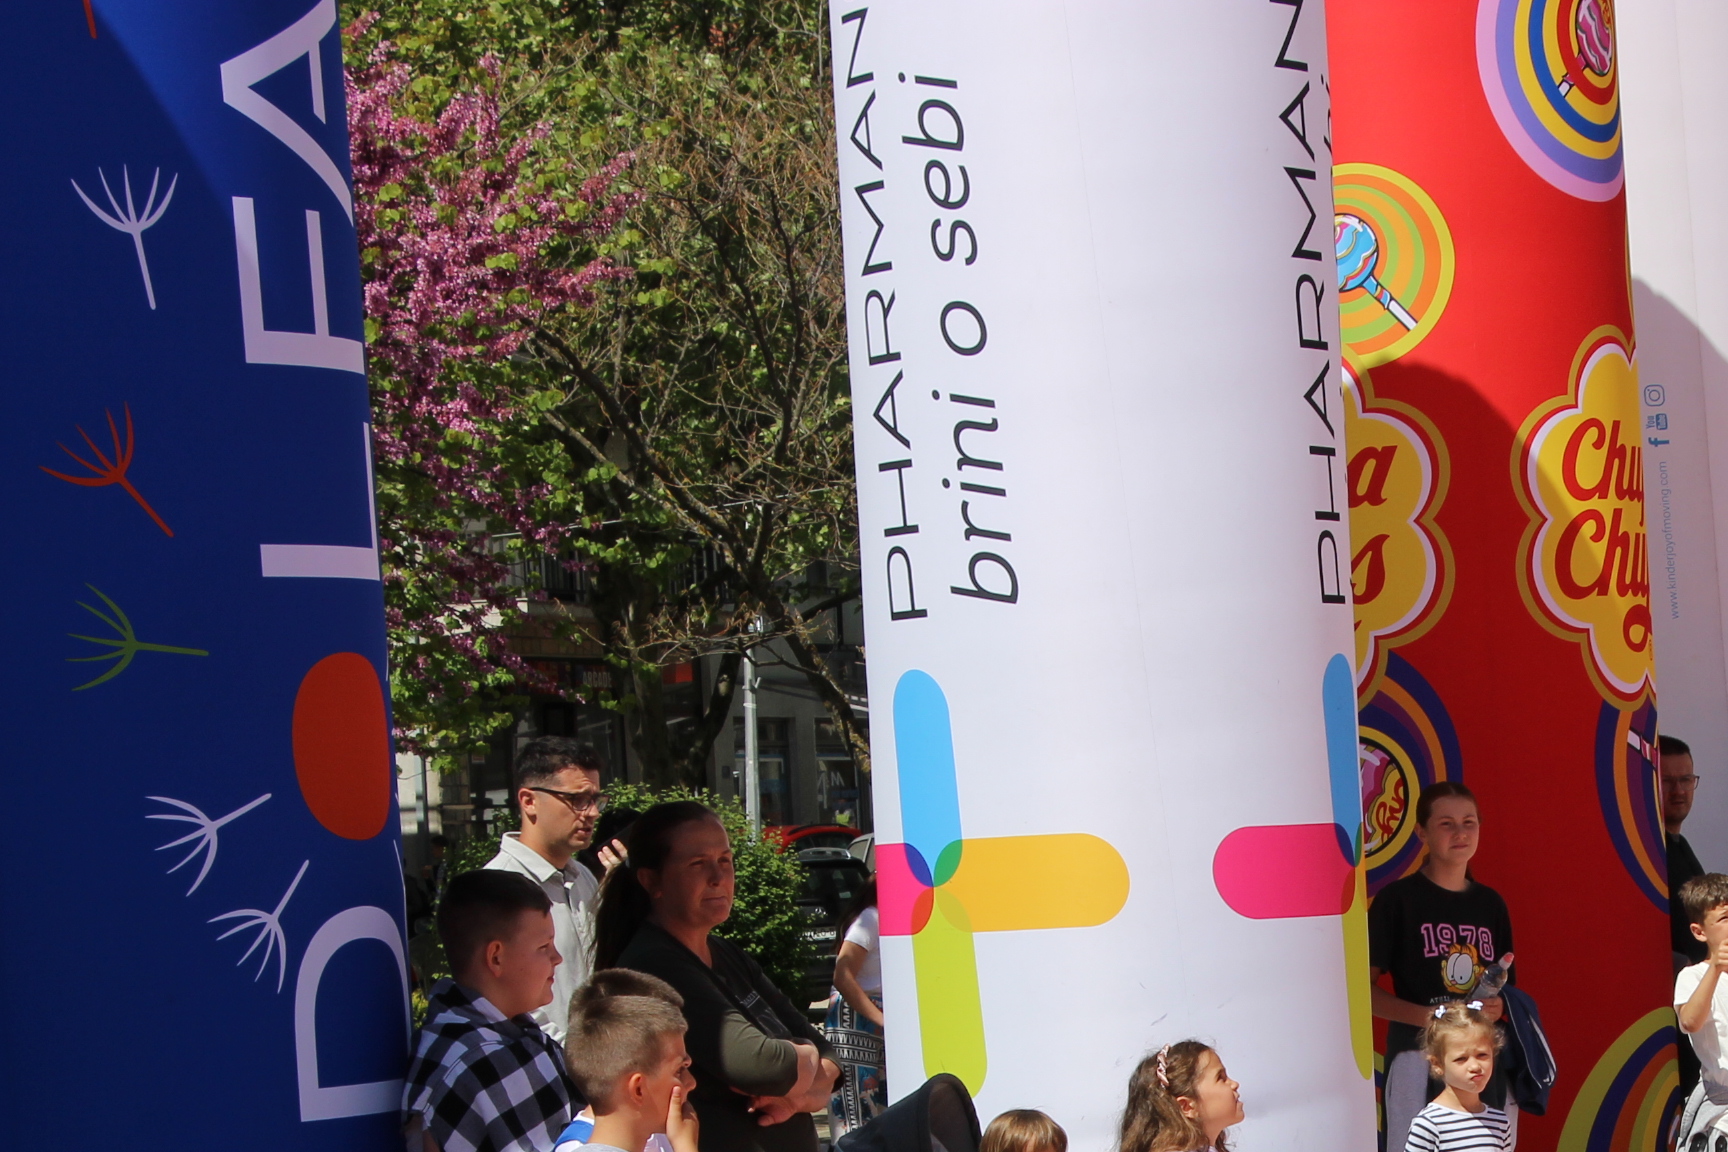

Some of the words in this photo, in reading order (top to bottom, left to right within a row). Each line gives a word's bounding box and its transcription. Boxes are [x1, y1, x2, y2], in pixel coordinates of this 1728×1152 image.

[897, 71, 979, 267] sebi
[940, 300, 988, 356] o
[932, 389, 1019, 605] brini
[1659, 461, 1680, 619] www.kinderjoyofmoving.com
[1421, 923, 1494, 961] 1978
